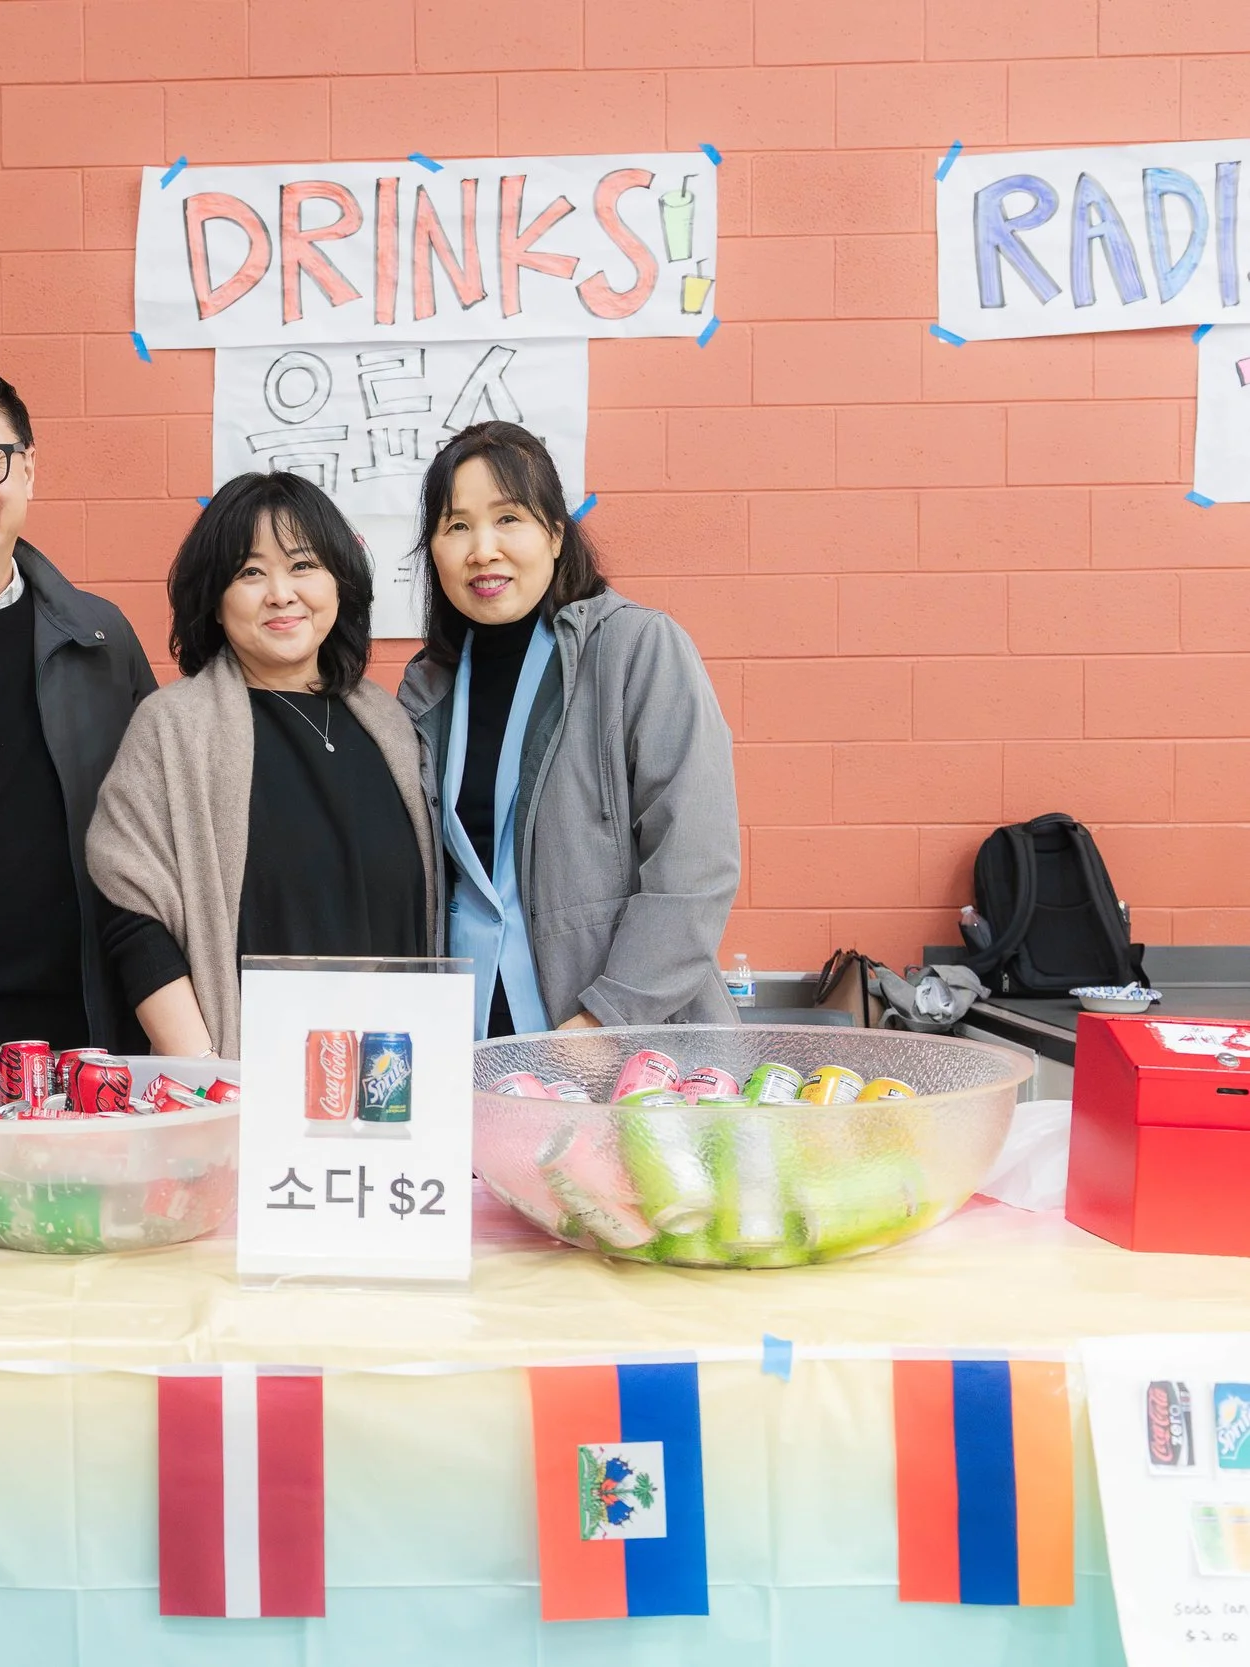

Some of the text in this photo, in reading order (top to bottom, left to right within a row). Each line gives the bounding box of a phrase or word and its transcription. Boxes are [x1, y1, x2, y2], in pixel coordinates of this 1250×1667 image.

[183, 168, 659, 325] DRINKS
[973, 160, 1250, 308] RADI
[368, 1059, 406, 1104] Sprite
[266, 1165, 446, 1221] 소다 $2
